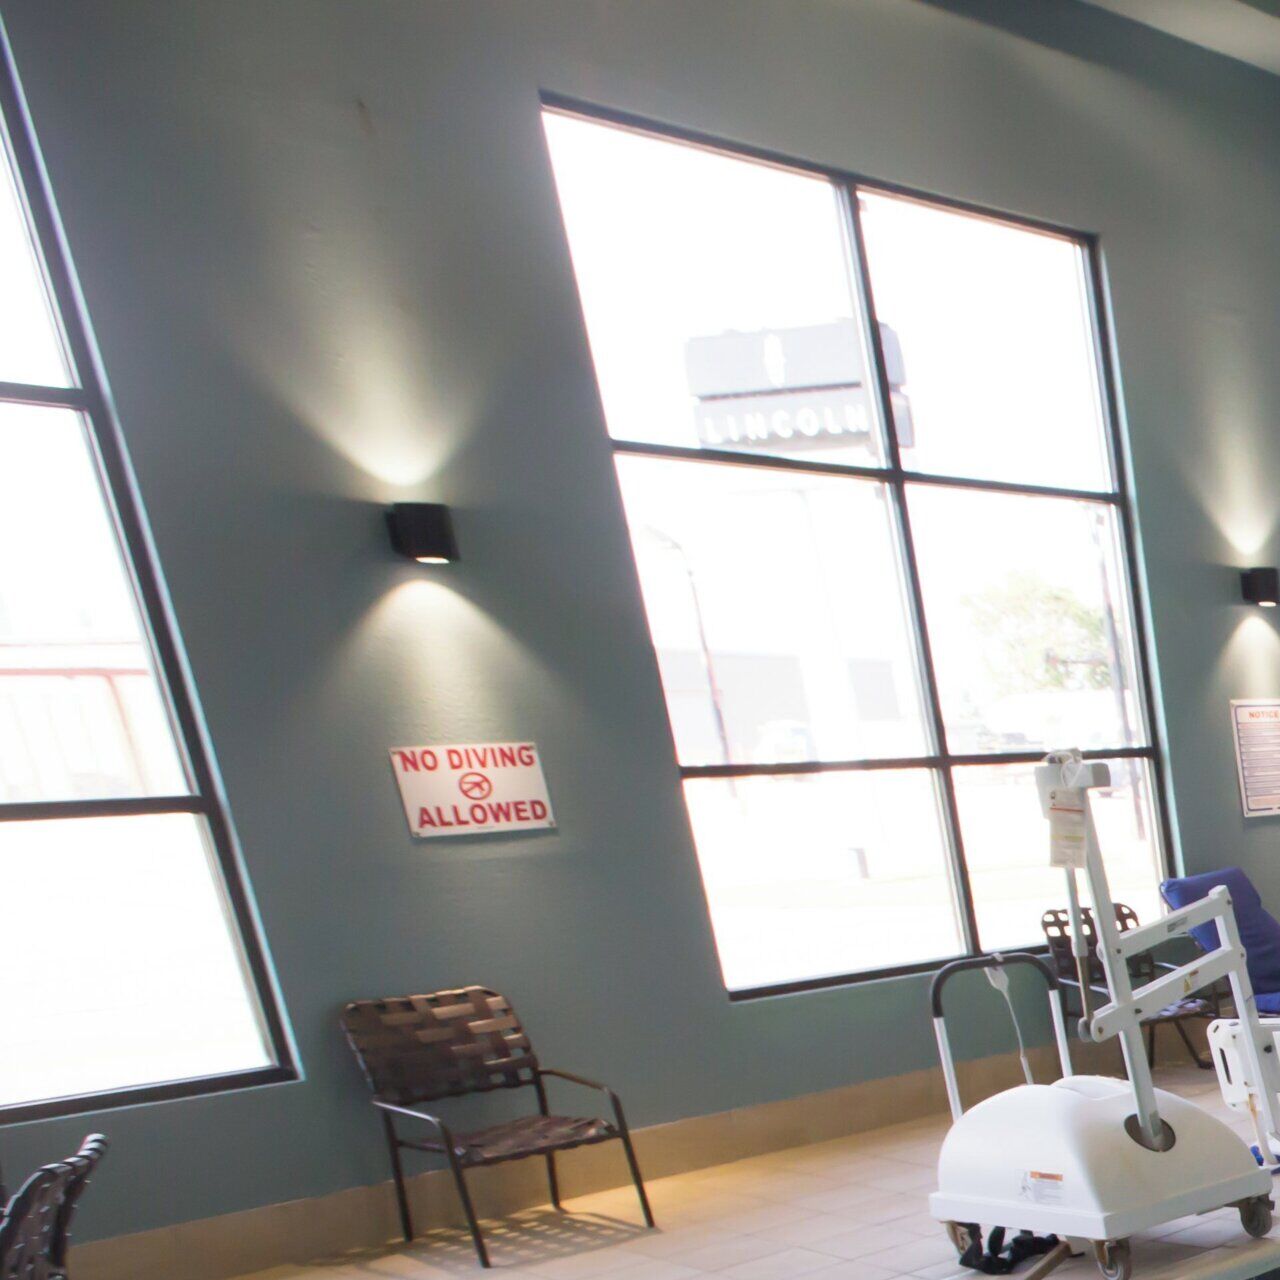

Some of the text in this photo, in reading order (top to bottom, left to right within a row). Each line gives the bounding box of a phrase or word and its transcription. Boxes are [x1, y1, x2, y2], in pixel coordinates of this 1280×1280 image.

[704, 404, 870, 444] LINCOLN
[1248, 710, 1280, 719] NOTICE
[400, 746, 536, 772] NO DIVING
[418, 800, 547, 828] ALLOWED
